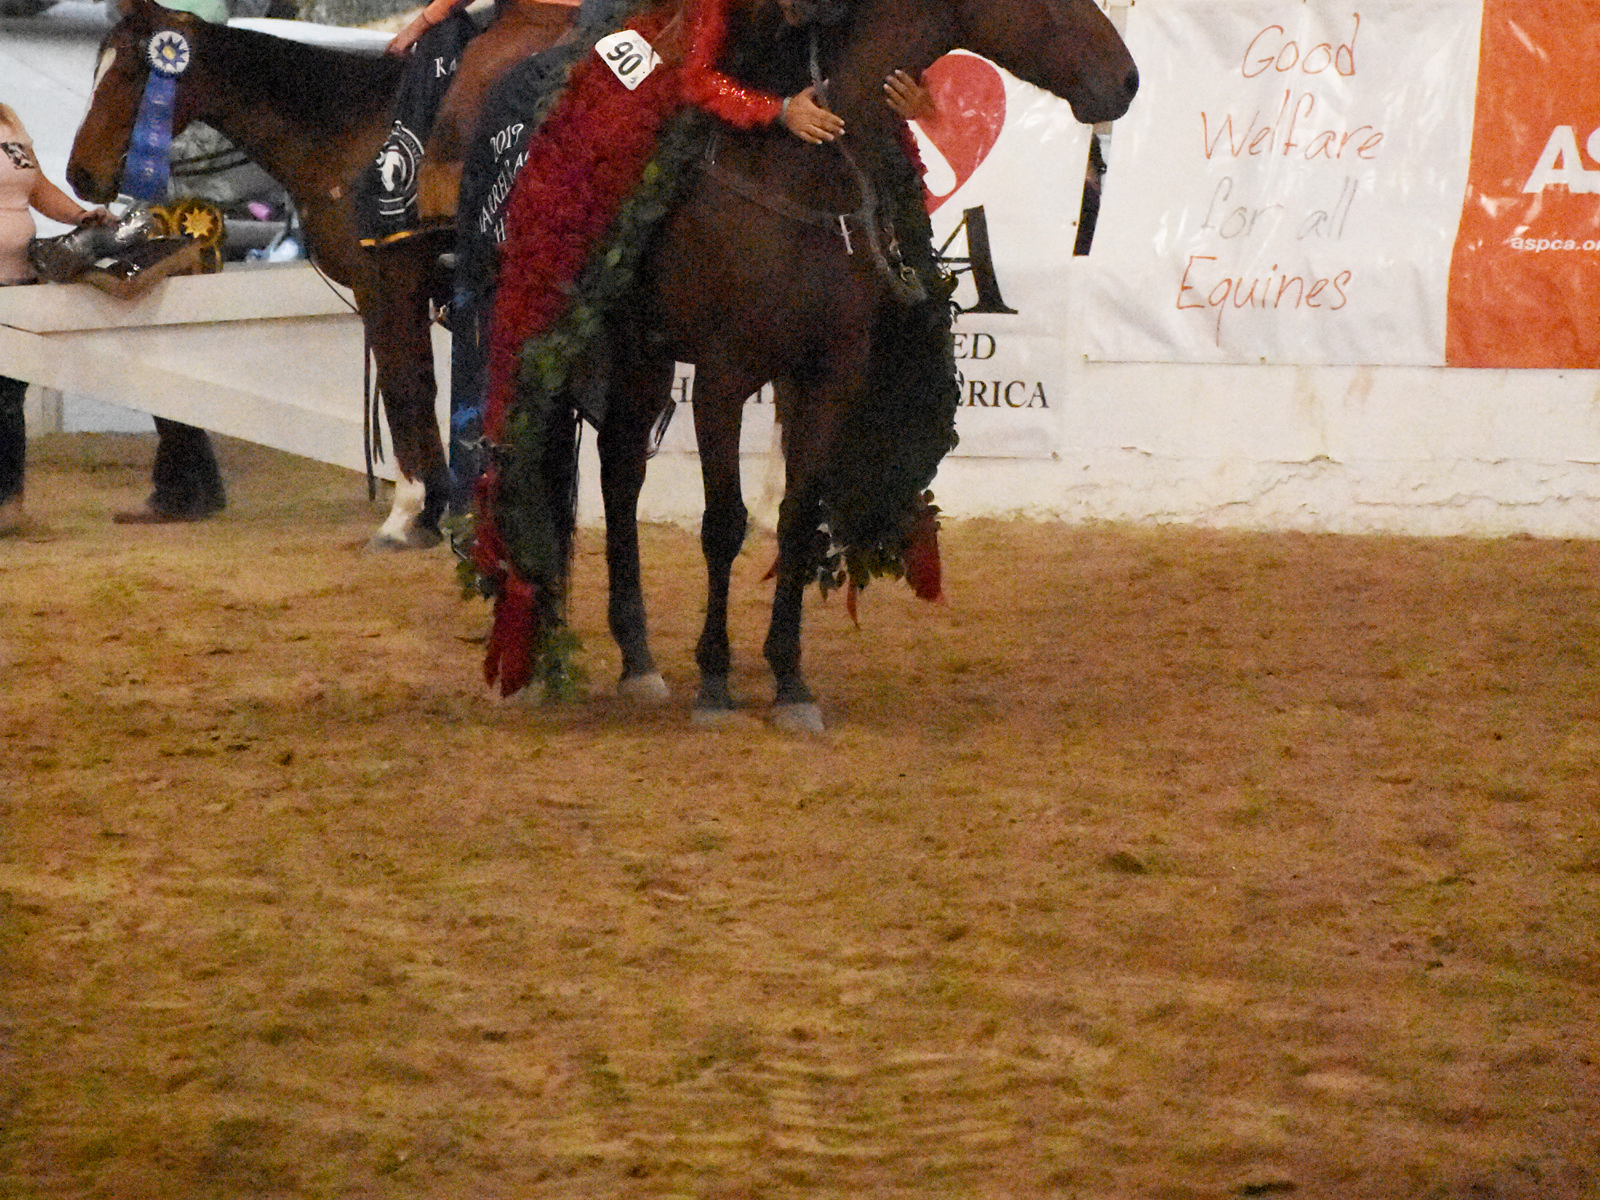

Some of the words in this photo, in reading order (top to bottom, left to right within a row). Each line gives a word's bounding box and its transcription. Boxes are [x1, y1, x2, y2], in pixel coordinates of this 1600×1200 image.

[606, 41, 644, 76] 90
[1242, 12, 1360, 79] Good
[1200, 89, 1385, 160] Welfare
[1201, 176, 1285, 240] for
[1297, 176, 1359, 242] all
[1176, 255, 1352, 347] Equines
